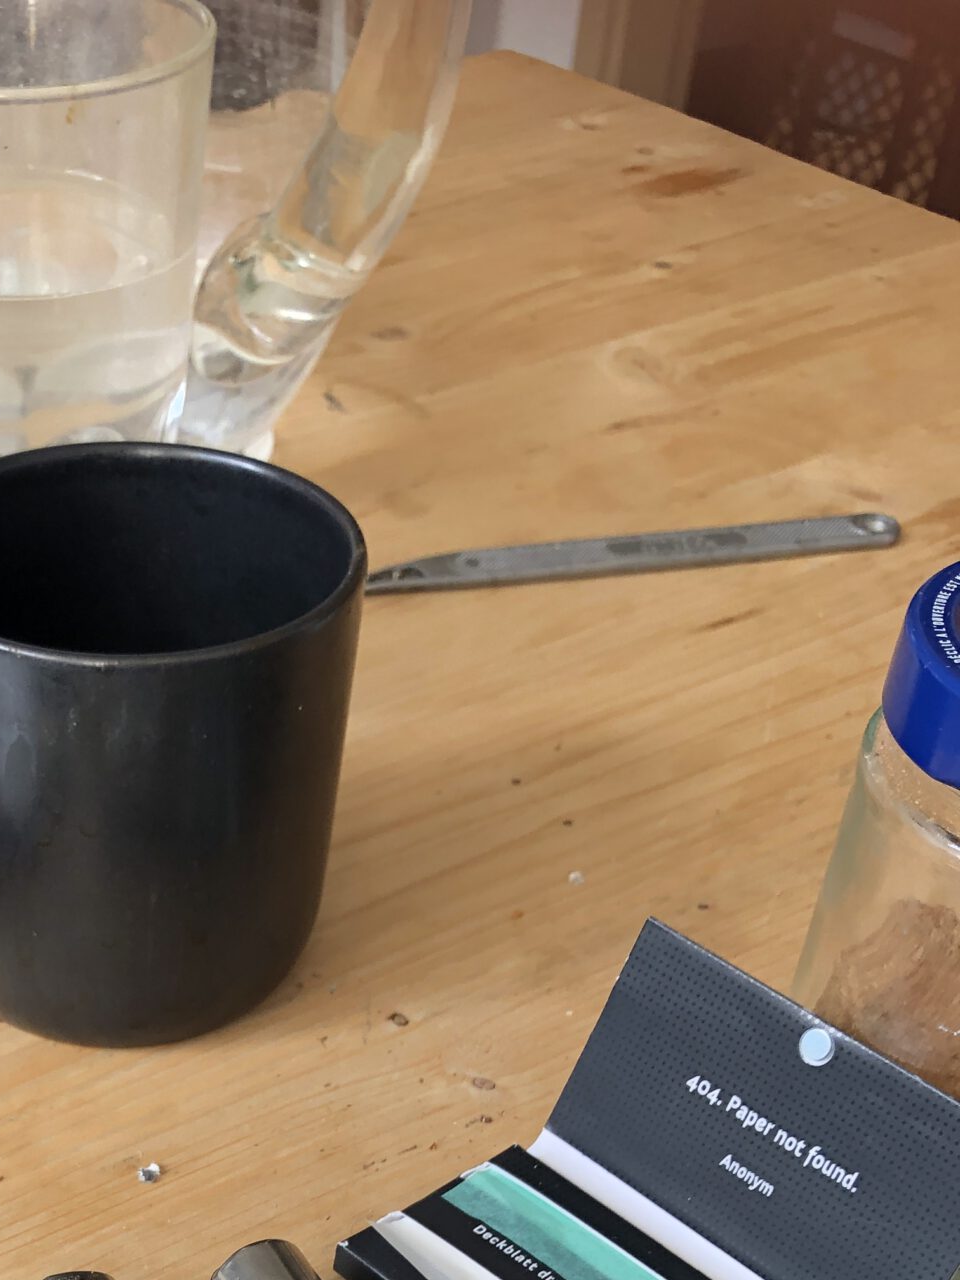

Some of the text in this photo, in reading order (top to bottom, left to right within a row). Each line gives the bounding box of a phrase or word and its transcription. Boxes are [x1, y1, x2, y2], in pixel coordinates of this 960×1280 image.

[686, 1075, 860, 1193] 404. Paper not found.
[718, 1153, 775, 1197] Anonym
[472, 1224, 539, 1273] Deckblatt
